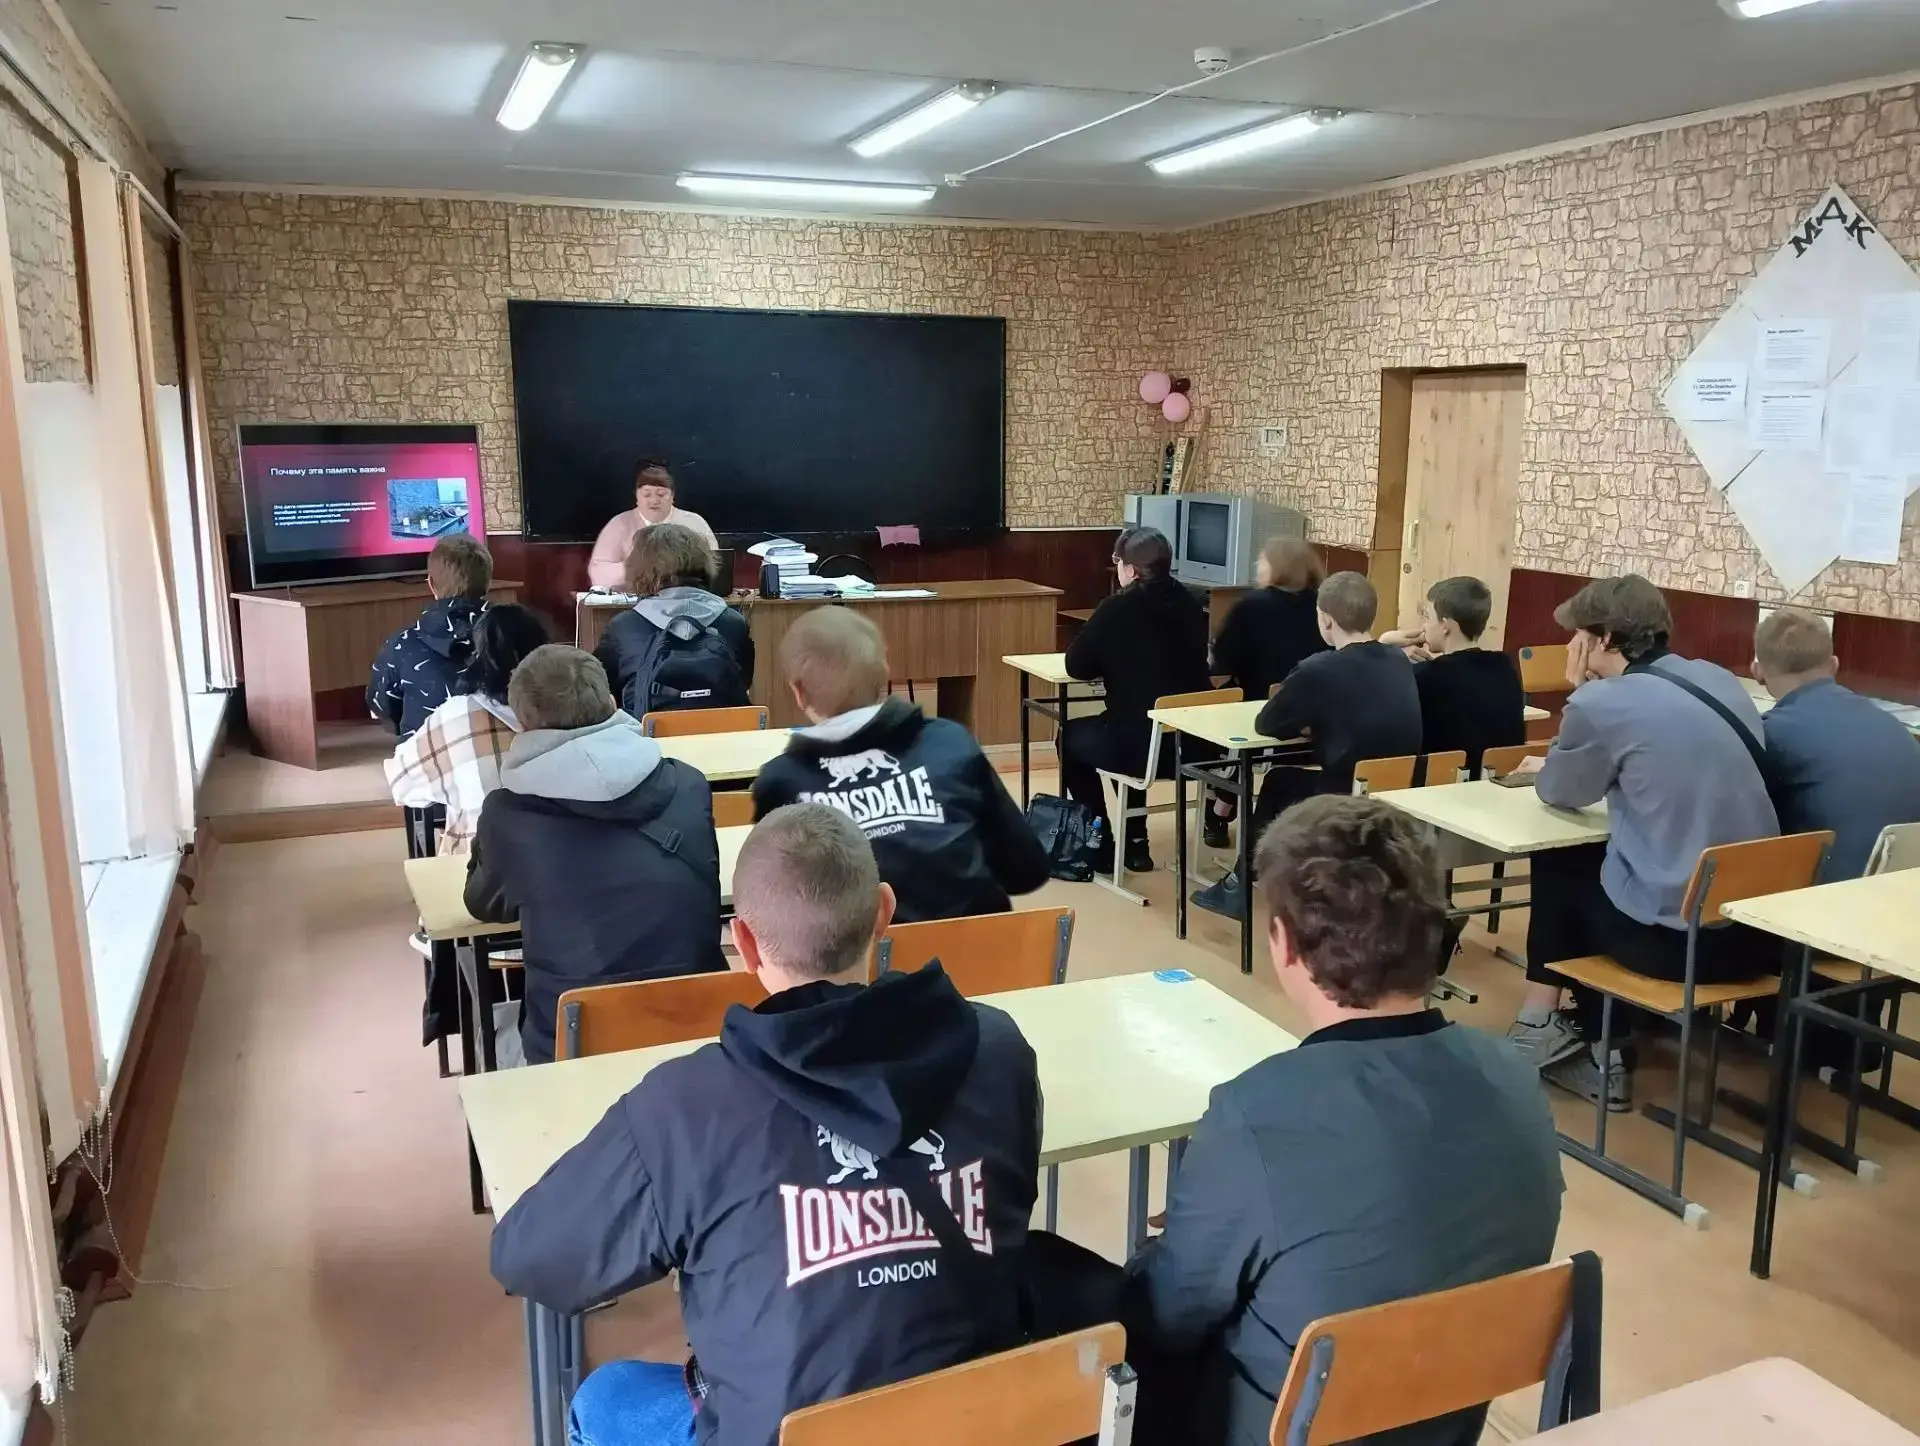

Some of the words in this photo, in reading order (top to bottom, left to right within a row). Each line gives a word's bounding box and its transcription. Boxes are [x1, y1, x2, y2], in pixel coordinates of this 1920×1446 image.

[1788, 196, 1875, 259] МДК
[270, 468, 306, 477] Почему
[359, 466, 386, 474] важна
[864, 821, 906, 840] ONDON
[857, 1258, 937, 1288] LONDON
